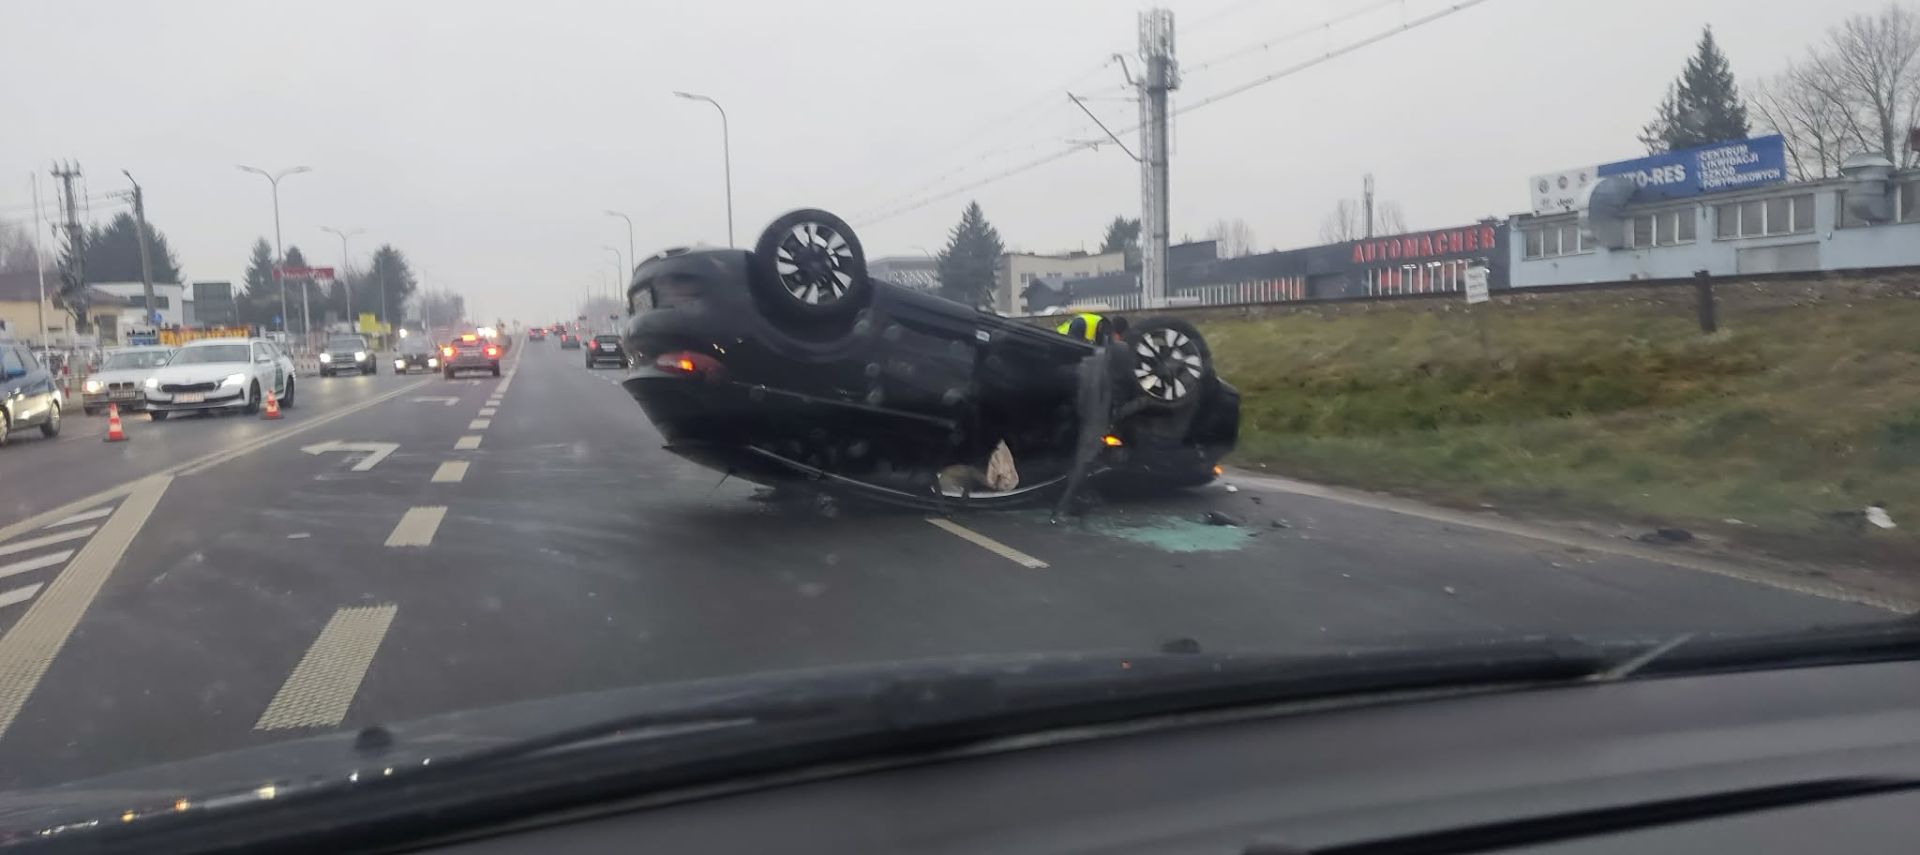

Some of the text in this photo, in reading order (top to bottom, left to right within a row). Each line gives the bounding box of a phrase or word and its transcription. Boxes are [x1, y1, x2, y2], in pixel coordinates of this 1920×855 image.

[1700, 144, 1749, 161] CENTRUM
[1701, 152, 1759, 171] LIKWIDACJI
[1618, 164, 1686, 188] TO-RES
[1354, 224, 1496, 263] AUTOMACHER
